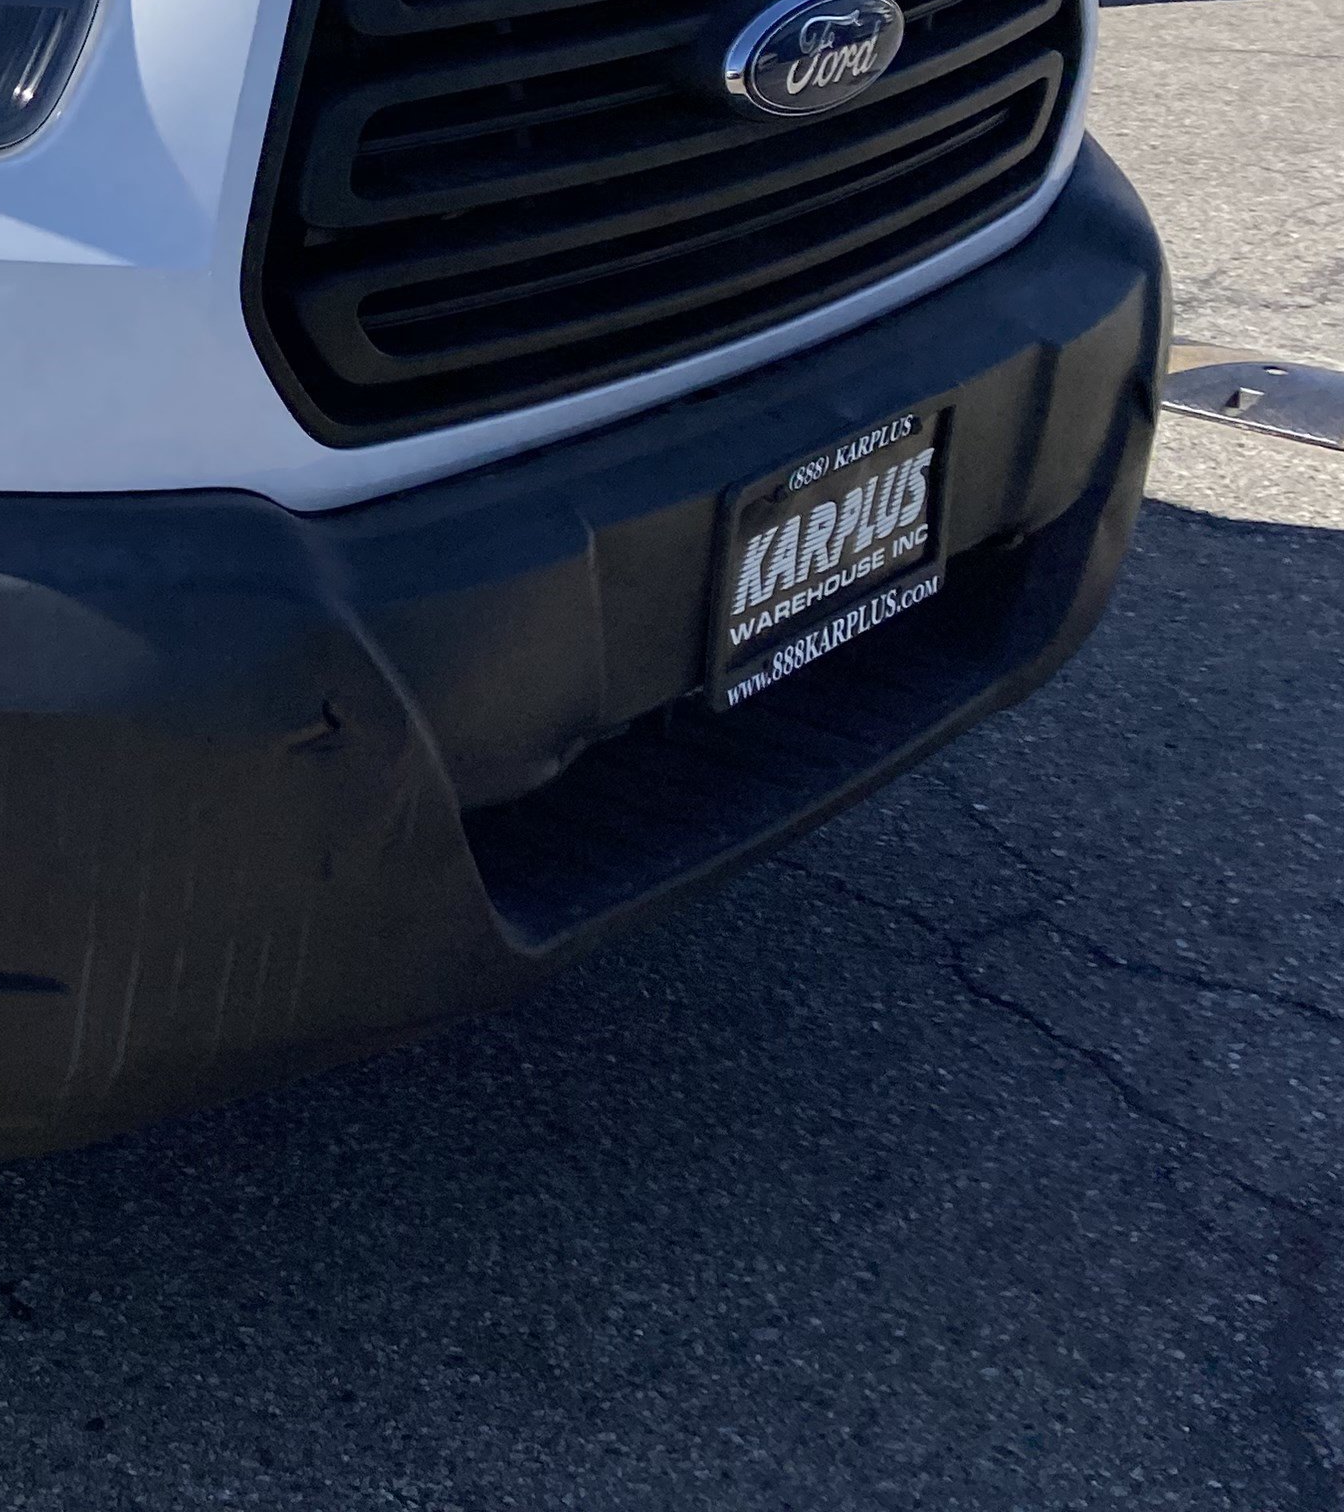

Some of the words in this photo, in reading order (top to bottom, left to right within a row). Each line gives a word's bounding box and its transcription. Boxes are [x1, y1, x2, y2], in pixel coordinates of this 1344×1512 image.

[786, 9, 881, 95] Ford
[788, 455, 830, 492] (888)
[833, 413, 914, 471] KARPLUS
[730, 447, 936, 616] KARPLUS
[729, 548, 886, 646] WAREHOUSE
[892, 523, 929, 558] INC
